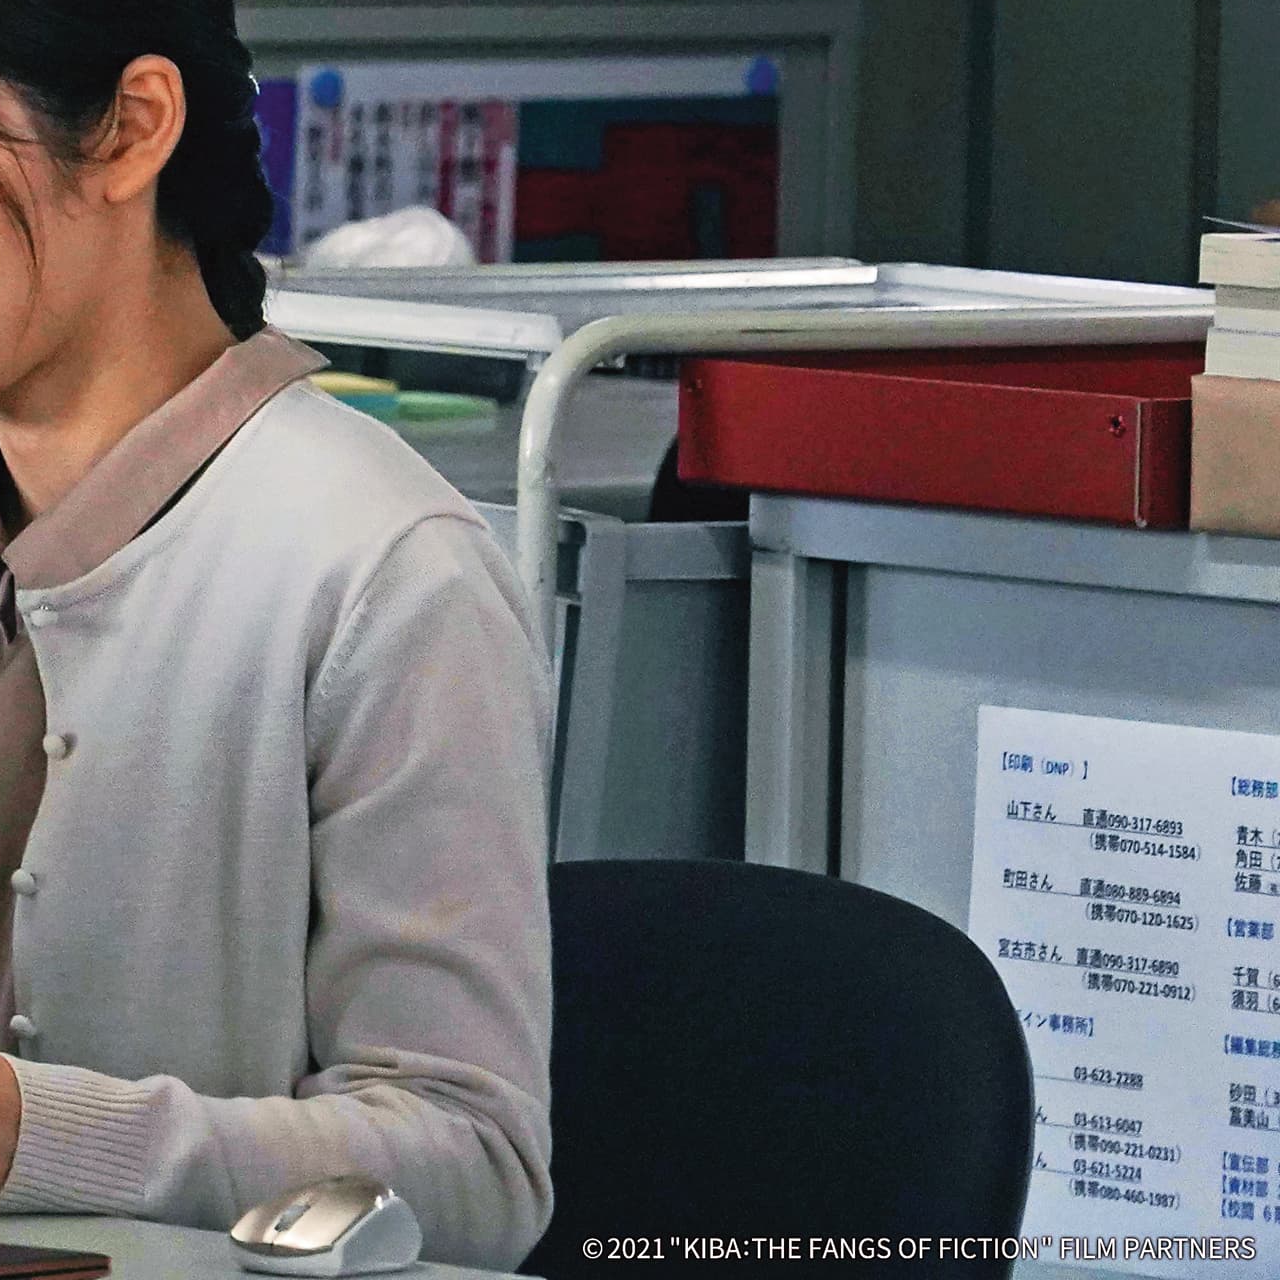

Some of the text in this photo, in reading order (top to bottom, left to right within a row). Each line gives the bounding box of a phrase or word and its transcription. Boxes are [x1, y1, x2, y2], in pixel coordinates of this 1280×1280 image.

[1006, 800, 1057, 822] 山下さん
[1236, 825, 1263, 847] 青木
[1235, 848, 1262, 869] 角田
[1002, 867, 1054, 891] 町田さん
[1016, 1009, 1095, 1038] イン事務所】
